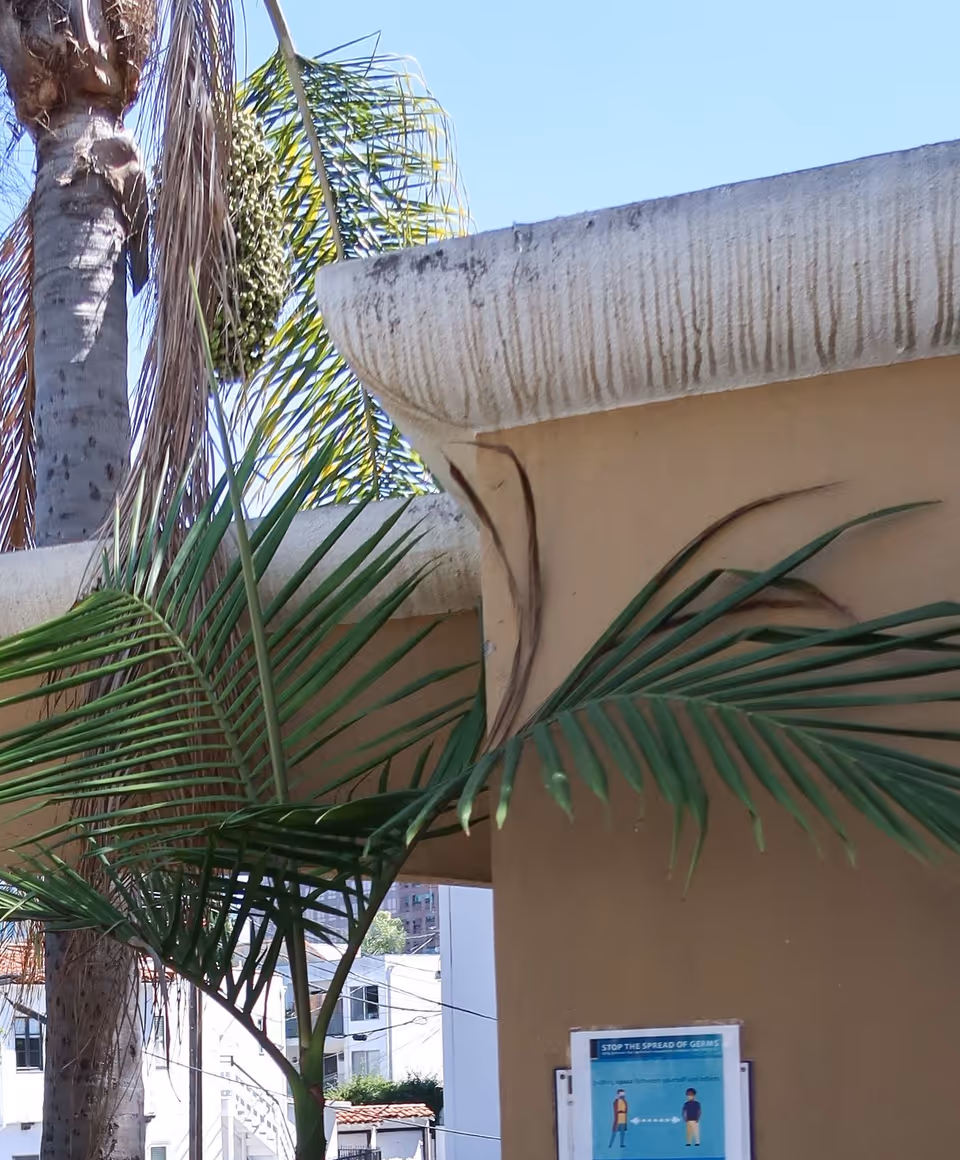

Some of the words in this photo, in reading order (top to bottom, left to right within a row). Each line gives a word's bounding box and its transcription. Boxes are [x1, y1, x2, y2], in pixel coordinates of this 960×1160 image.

[601, 1044, 623, 1052] STOP
[625, 1043, 640, 1051] THE
[641, 1041, 674, 1050] SPREAD
[689, 1040, 720, 1048] GERMS
